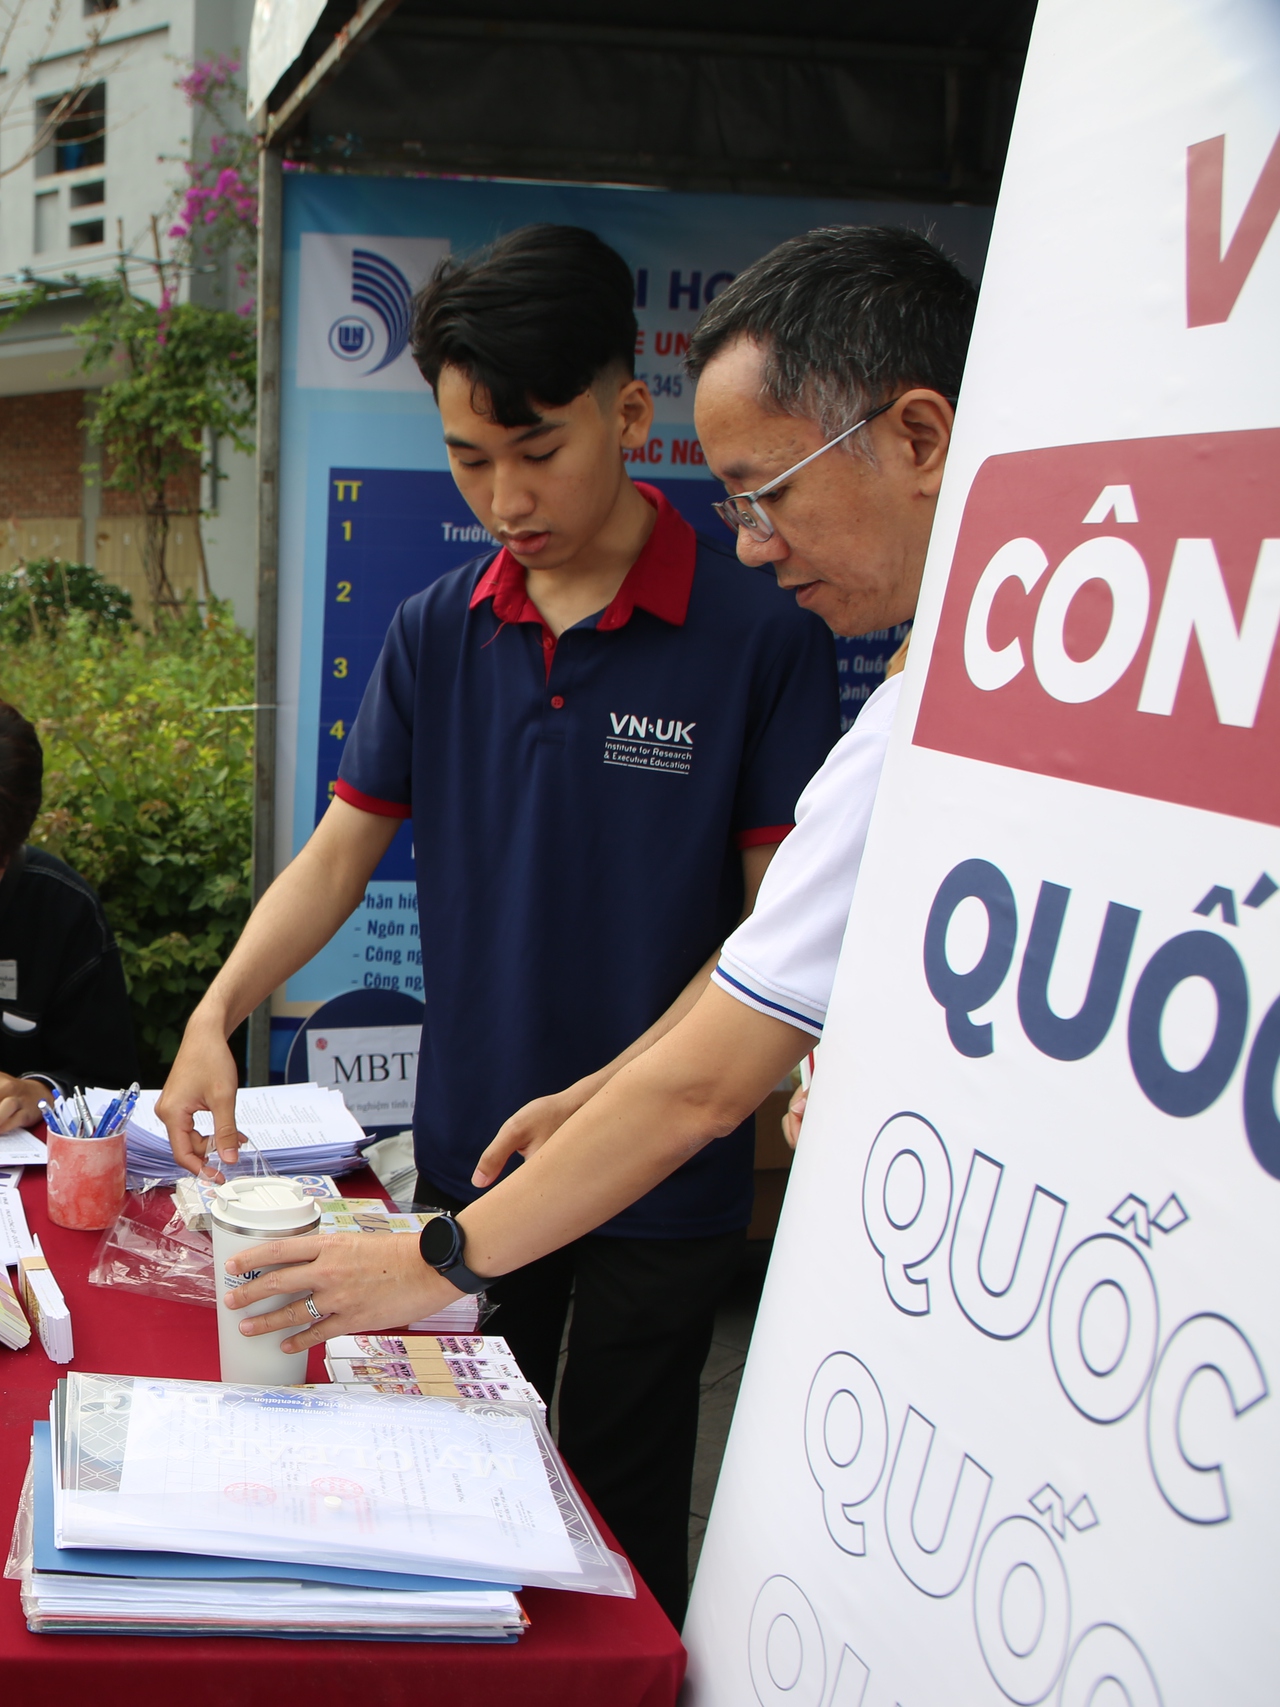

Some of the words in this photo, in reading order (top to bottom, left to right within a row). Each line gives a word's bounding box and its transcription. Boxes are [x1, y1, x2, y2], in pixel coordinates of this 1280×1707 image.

[333, 479, 363, 502] TT
[341, 520, 352, 542] 1
[336, 580, 352, 602] 2
[333, 656, 348, 679] 3
[329, 719, 345, 740] 4
[603, 750, 610, 760] &
[612, 751, 648, 765] Executive
[649, 757, 690, 771] Education
[604, 741, 637, 754] Institute
[639, 745, 651, 755] for
[652, 747, 692, 760] Research
[367, 919, 405, 939] Ngôn
[365, 945, 402, 966] Công
[250, 1396, 312, 1408] Presentation.
